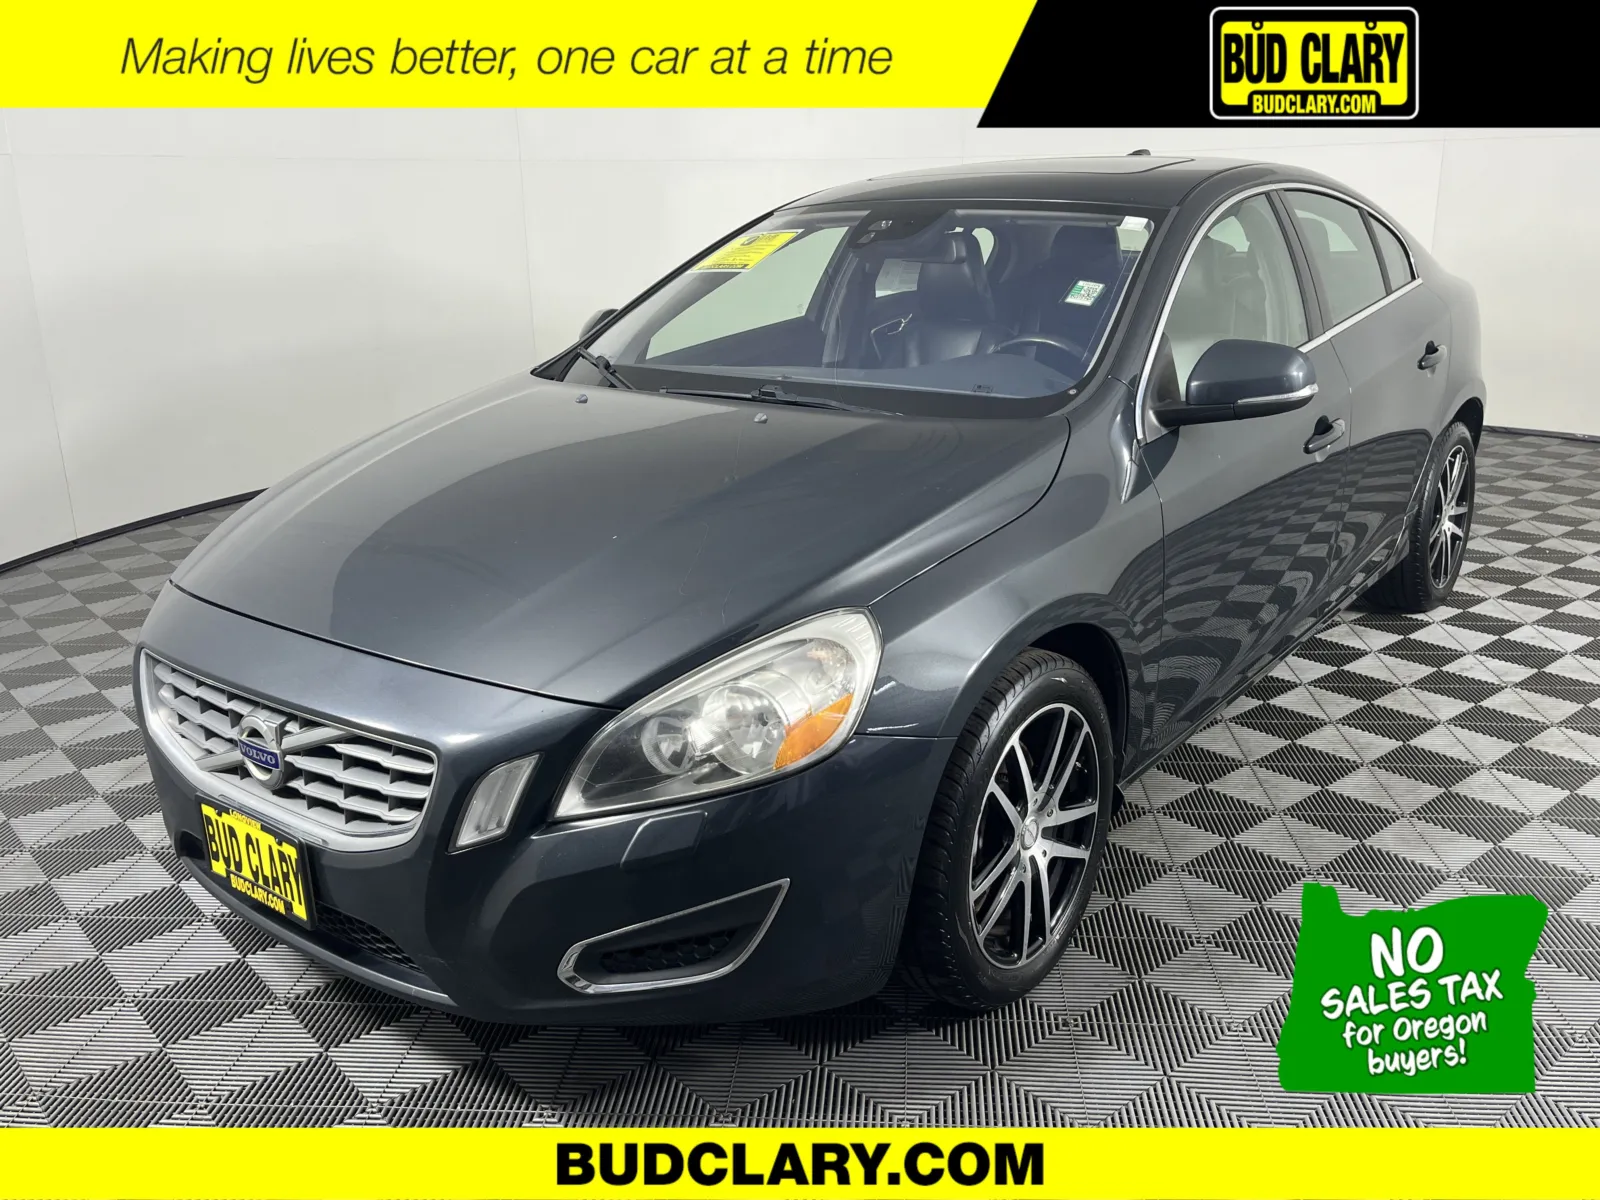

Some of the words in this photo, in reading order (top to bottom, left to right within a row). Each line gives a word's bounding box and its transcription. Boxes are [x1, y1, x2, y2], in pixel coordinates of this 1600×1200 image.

[240, 743, 276, 765] VOLVO
[204, 813, 243, 874] BUD
[245, 832, 302, 906] CLARY
[230, 873, 286, 915] BUDCLARY.COM
